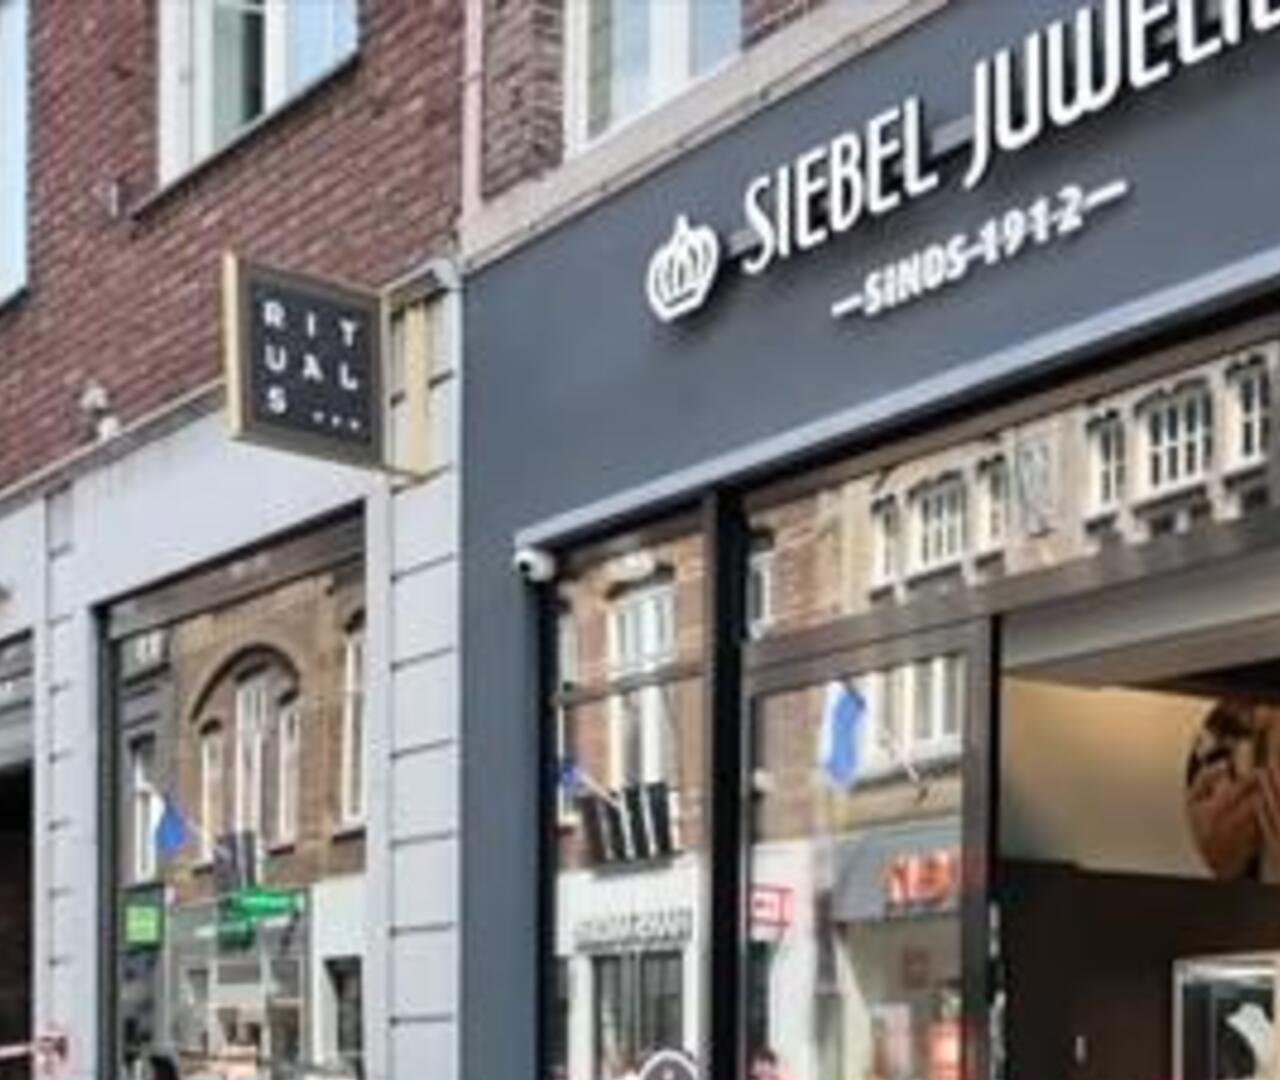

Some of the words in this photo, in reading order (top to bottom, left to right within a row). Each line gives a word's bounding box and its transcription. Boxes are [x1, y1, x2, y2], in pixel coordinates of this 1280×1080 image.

[741, 95, 939, 275] SIEBEL
[864, 232, 968, 315] SINDS
[980, 184, 1083, 265] 1912
